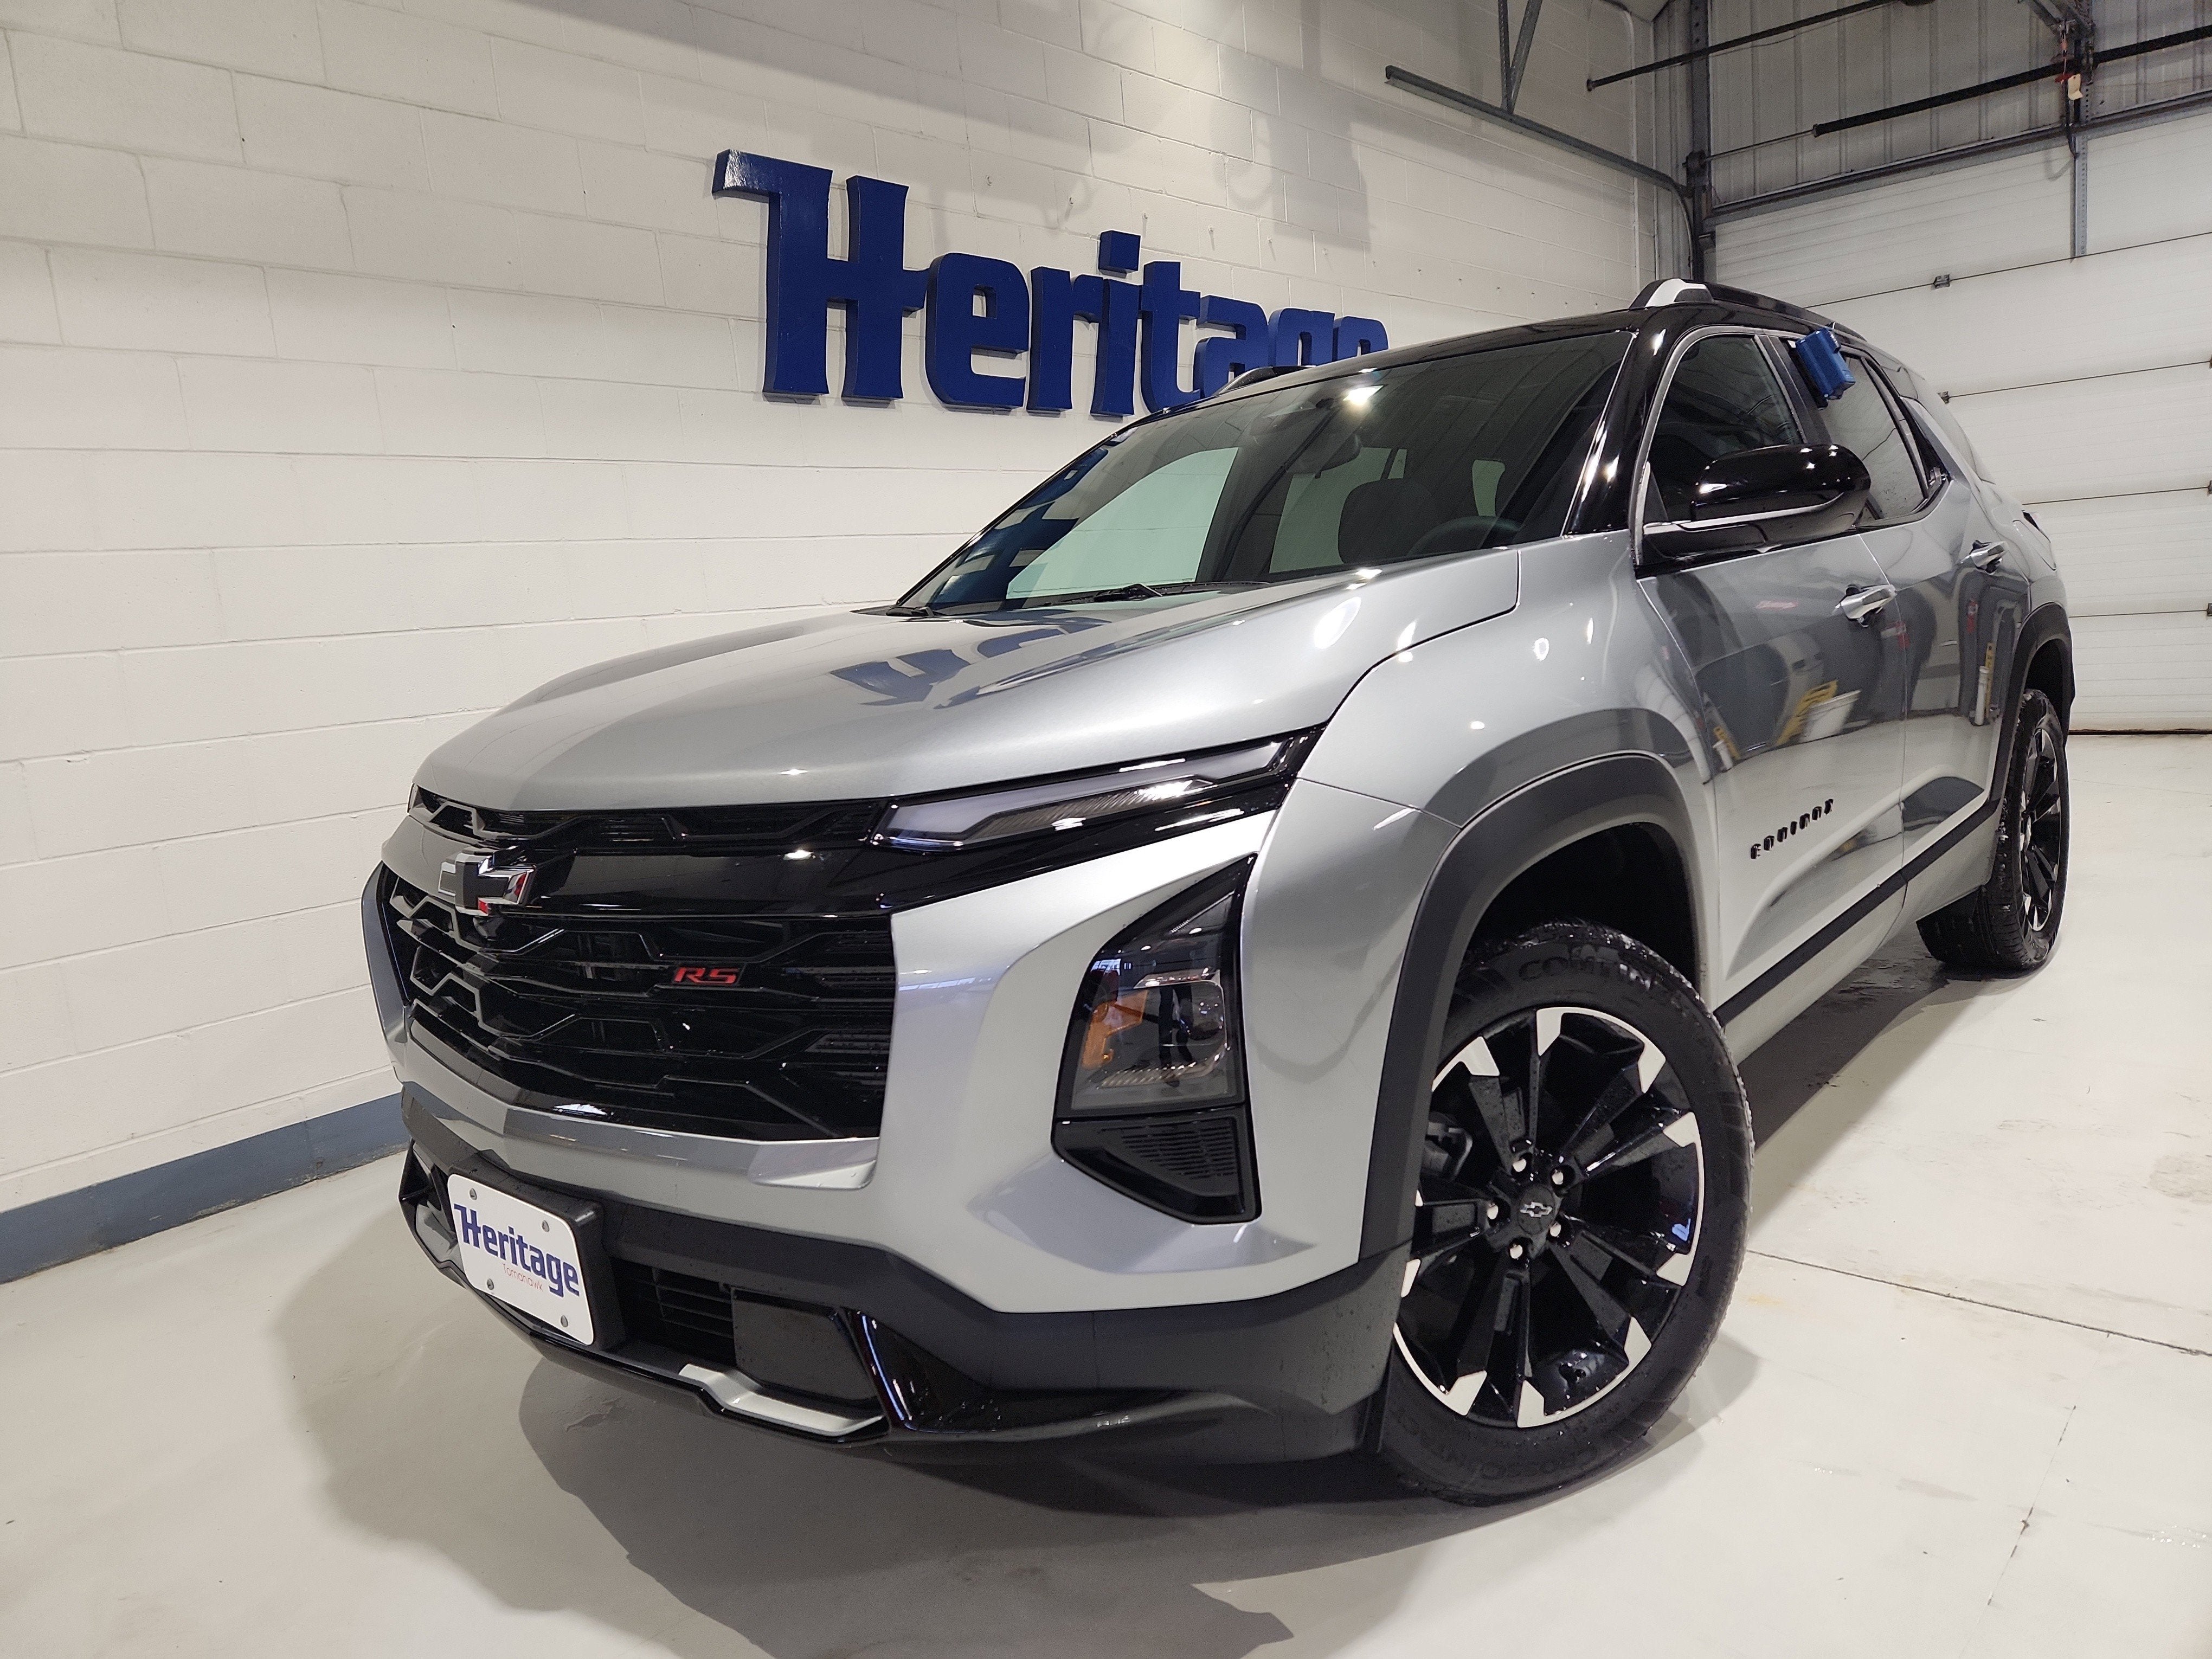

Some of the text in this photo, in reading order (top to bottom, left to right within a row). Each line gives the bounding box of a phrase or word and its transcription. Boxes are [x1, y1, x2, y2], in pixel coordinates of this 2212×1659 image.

[674, 967, 740, 985] RS
[454, 1204, 580, 1297] Heritage
[503, 1263, 543, 1291] Tomahawk
